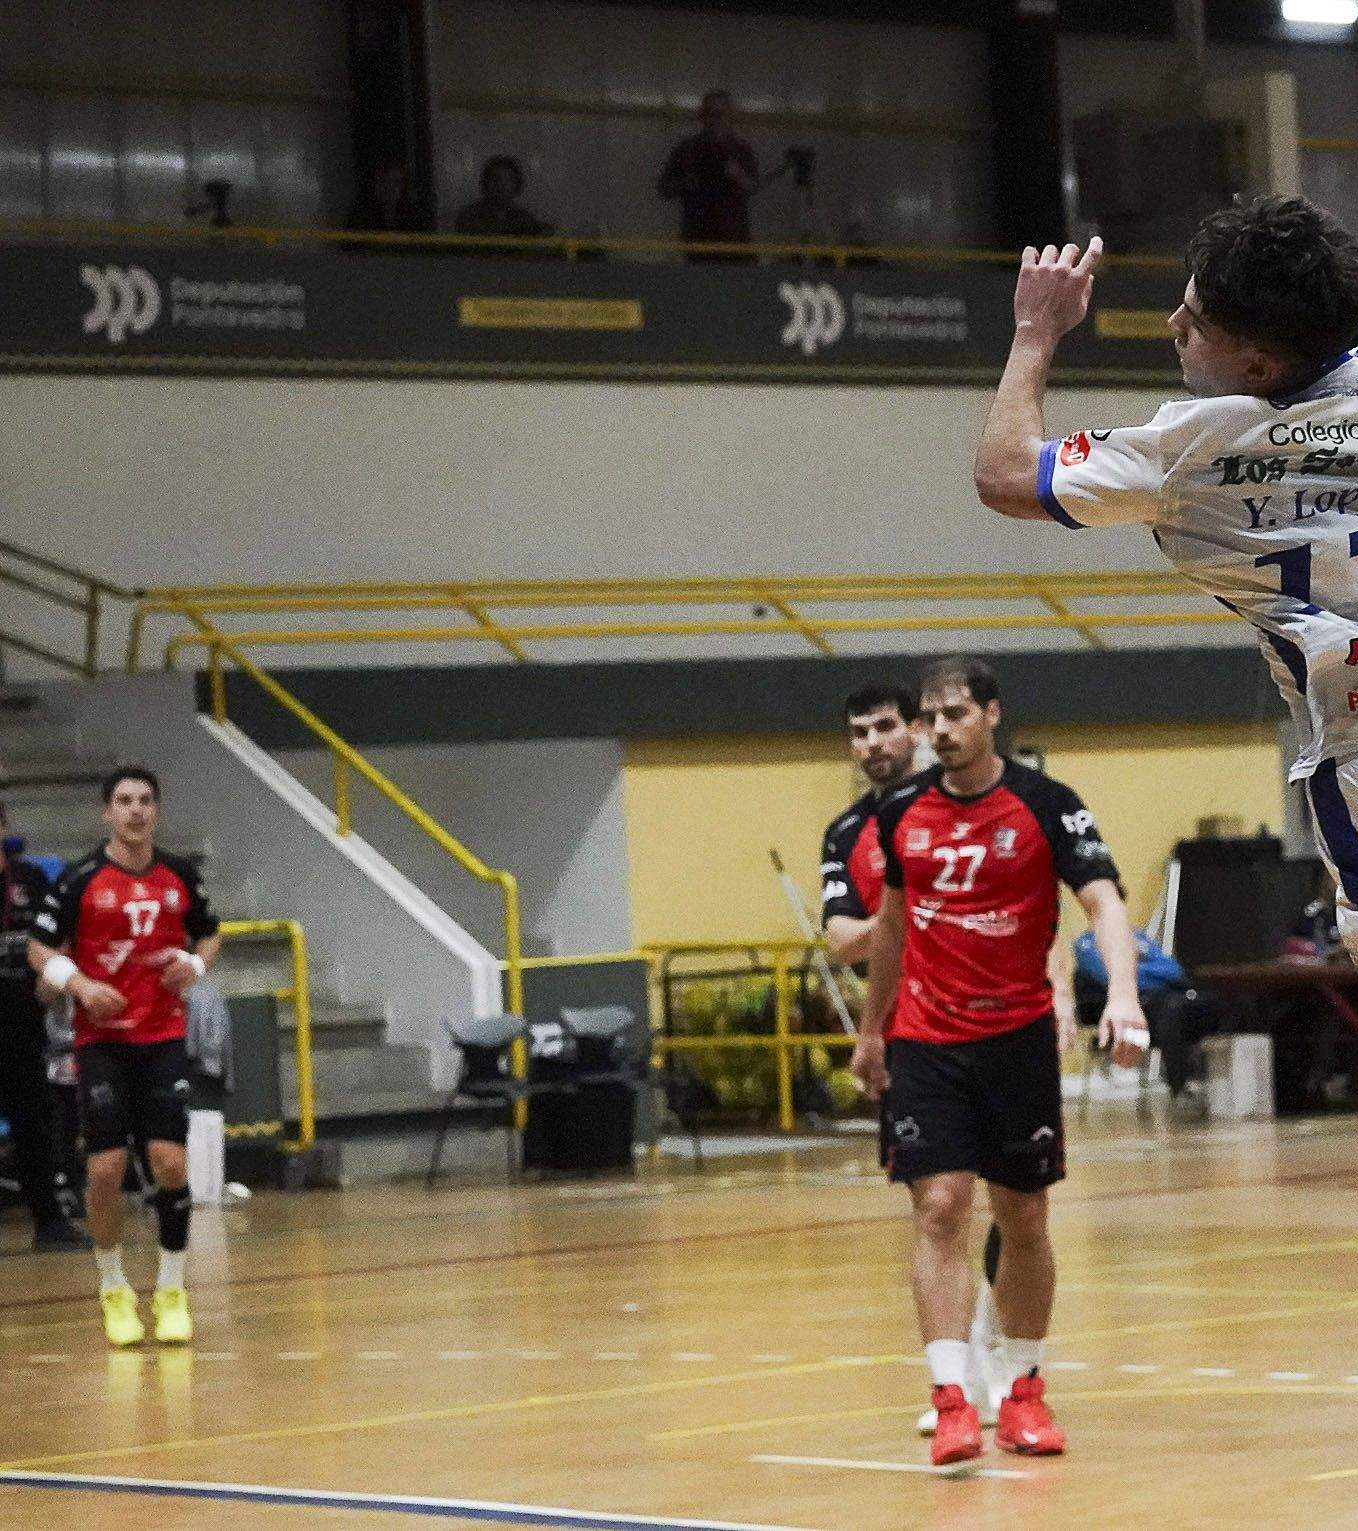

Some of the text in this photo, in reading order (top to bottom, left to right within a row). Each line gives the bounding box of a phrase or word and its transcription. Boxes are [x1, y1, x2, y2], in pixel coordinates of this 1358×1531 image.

[1212, 454, 1289, 486] Los
[1242, 496, 1277, 529] Y.
[932, 844, 987, 892] 27
[122, 899, 162, 937] 17
